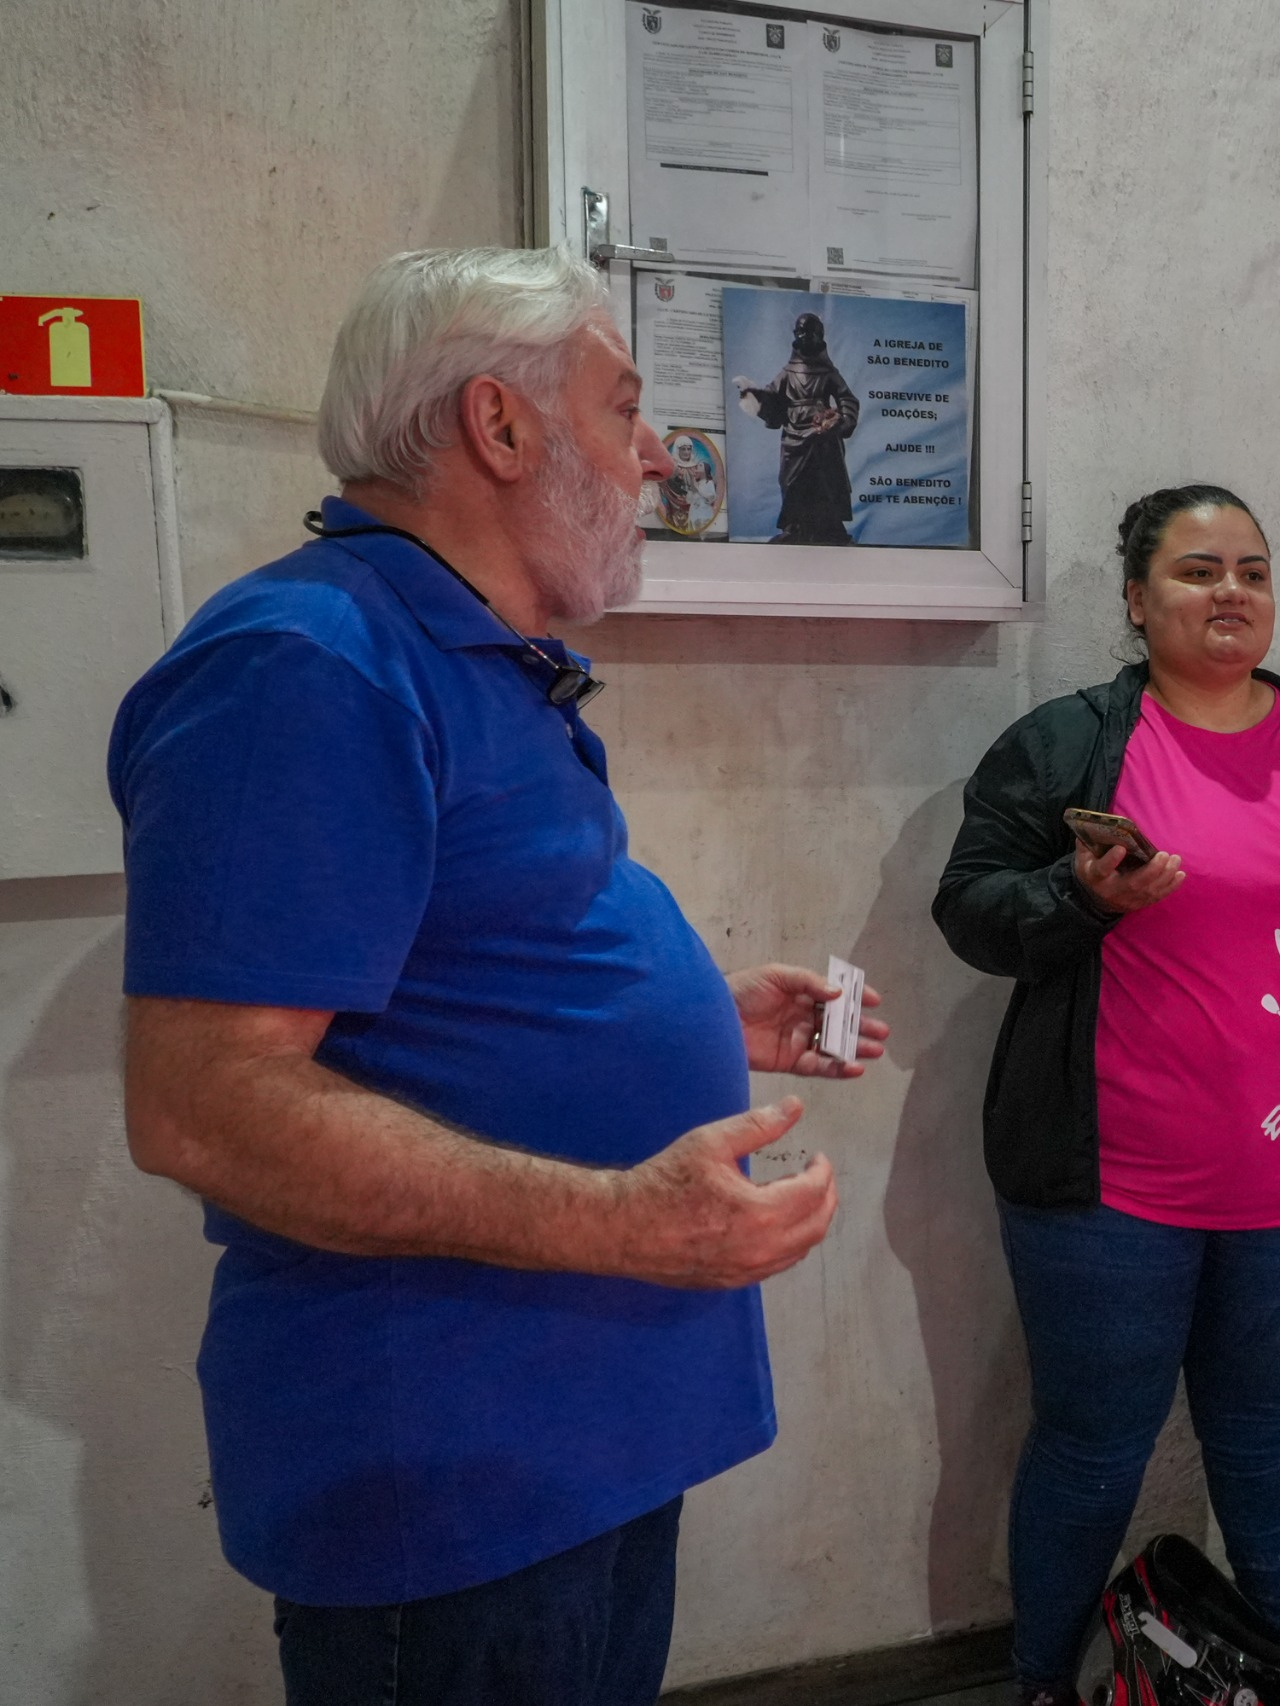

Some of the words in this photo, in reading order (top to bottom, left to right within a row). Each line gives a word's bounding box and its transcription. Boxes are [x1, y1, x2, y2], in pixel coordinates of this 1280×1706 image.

[873, 340, 881, 348] A
[885, 340, 926, 351] IGREJA
[929, 343, 944, 352] DE
[867, 355, 890, 365] SÃO
[893, 357, 950, 369] BENEDITO
[868, 390, 932, 402] SOBREVIVE
[935, 394, 950, 403] DE
[881, 408, 938, 421] DOAÇÕES;
[885, 443, 922, 454] AJUDE
[925, 445, 936, 454] !!!
[869, 477, 893, 486] SÃO
[896, 478, 951, 488] BENEDITO
[859, 494, 883, 504] QUE
[886, 495, 900, 504] TE
